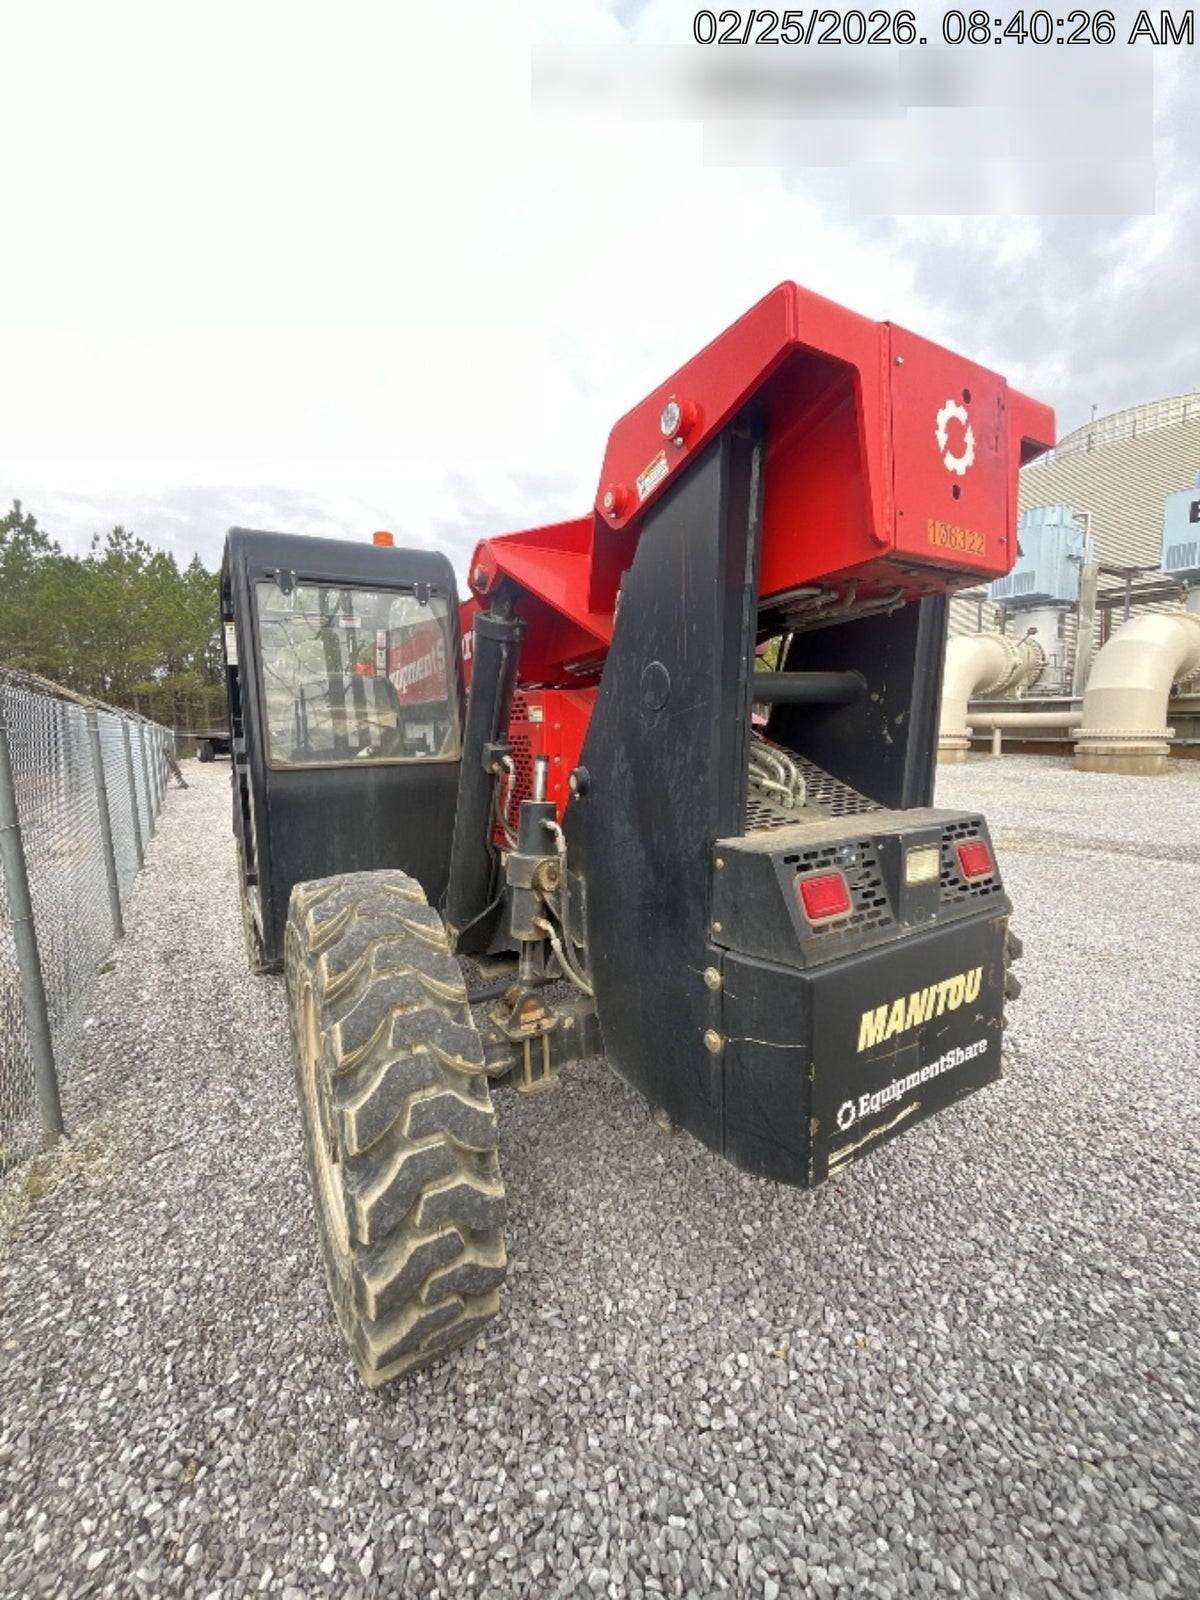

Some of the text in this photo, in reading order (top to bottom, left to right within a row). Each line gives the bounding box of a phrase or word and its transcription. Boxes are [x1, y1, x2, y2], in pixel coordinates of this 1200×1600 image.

[929, 521, 985, 556] 106322
[857, 966, 984, 1053] MANITOU
[858, 1039, 988, 1116] EquipmentShare
